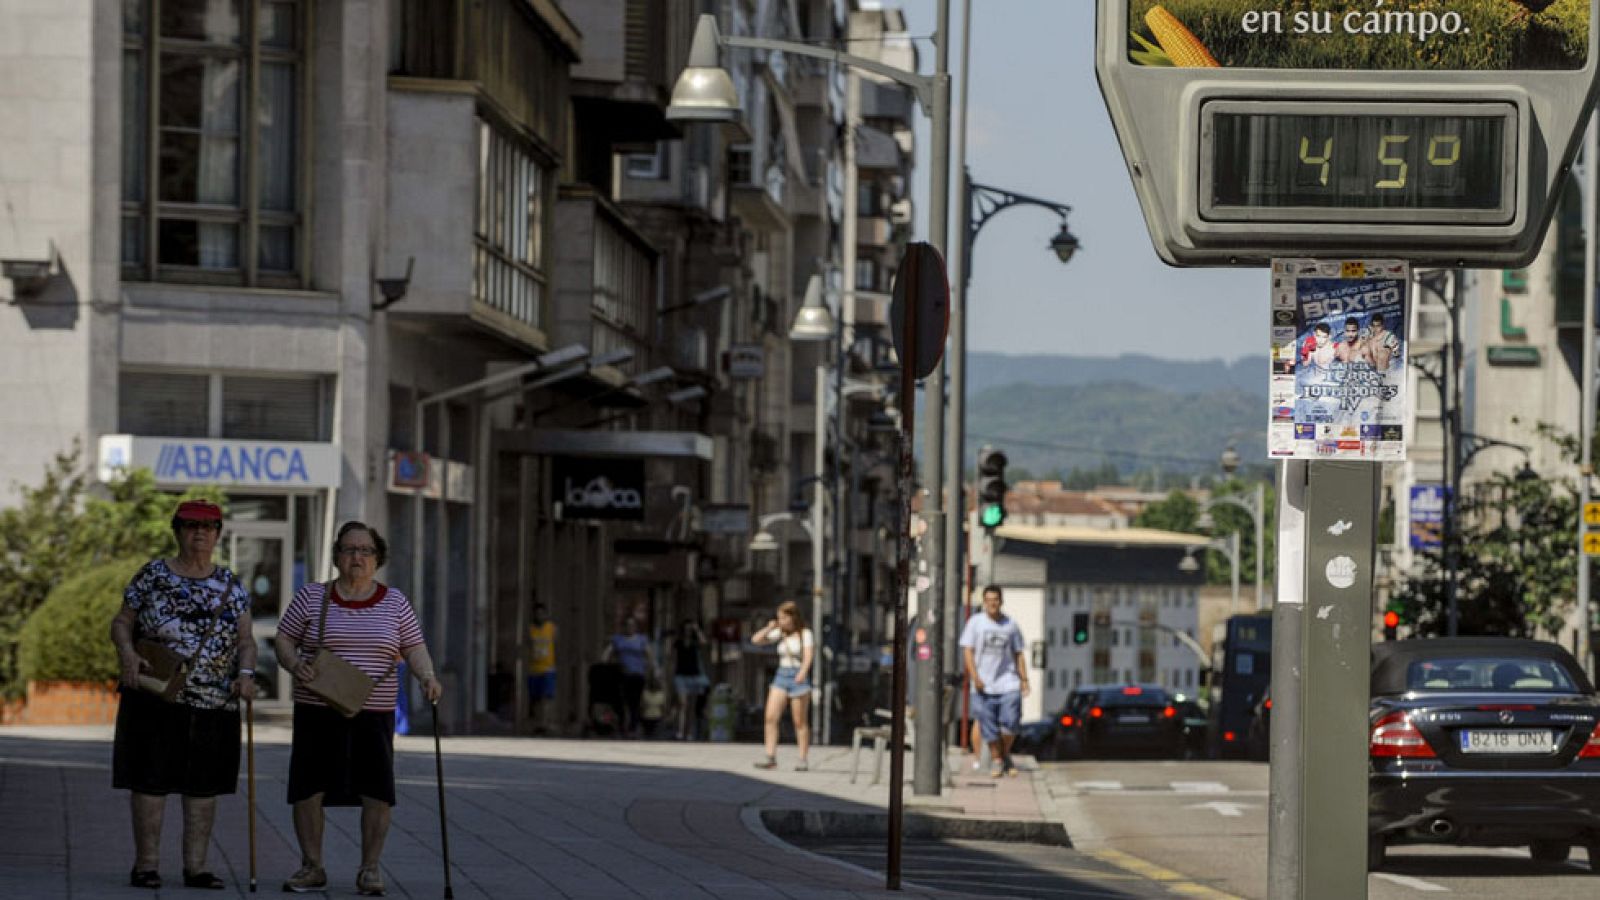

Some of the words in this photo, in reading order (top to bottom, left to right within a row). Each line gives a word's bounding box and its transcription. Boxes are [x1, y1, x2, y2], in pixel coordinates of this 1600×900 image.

[1241, 11, 1283, 34] en
[1293, 11, 1333, 34] su
[1343, 10, 1471, 42] campo.
[1303, 287, 1399, 318] BOXEO
[170, 443, 308, 481] ABANCA
[1472, 731, 1510, 747] 8218
